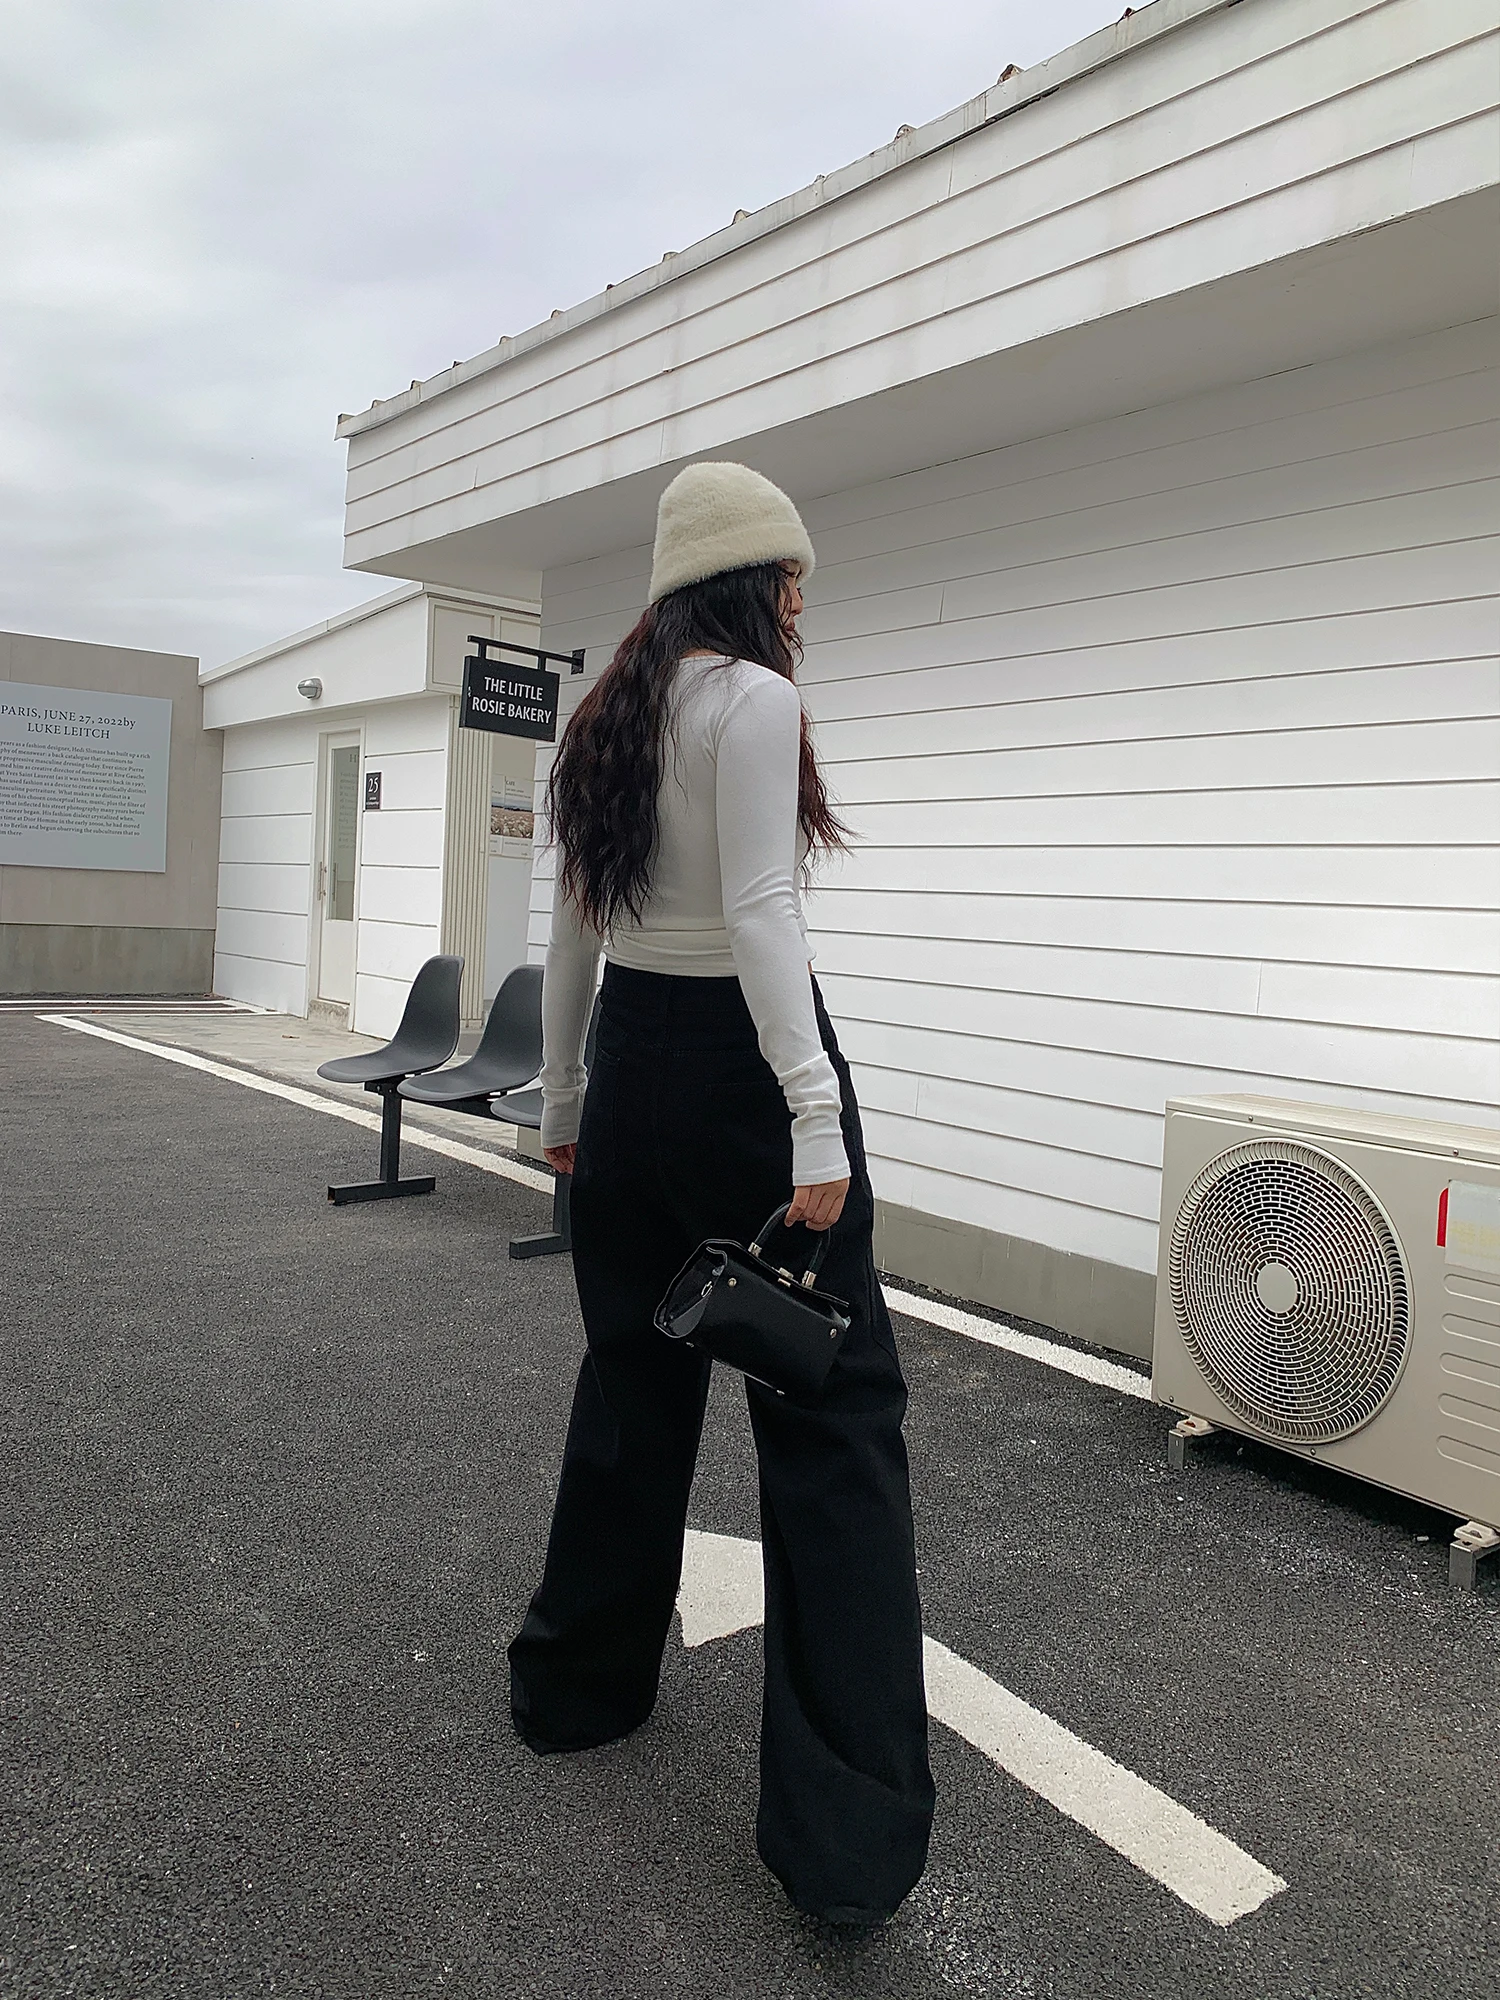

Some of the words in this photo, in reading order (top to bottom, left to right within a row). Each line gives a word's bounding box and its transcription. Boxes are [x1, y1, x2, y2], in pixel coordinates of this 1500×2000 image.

[484, 676, 506, 694] THE
[508, 681, 544, 702] LITTLE
[1, 705, 41, 718] PARIS,
[44, 709, 76, 722] JUNE
[78, 715, 94, 724] 27,
[98, 716, 136, 730] 2022by
[472, 696, 506, 716] ROSIE
[508, 703, 552, 724] BAKERY
[28, 722, 60, 735] LUKE
[64, 726, 110, 739] LEITCH
[47, 744, 70, 752] designer,
[63, 760, 84, 768] dressing
[368, 777, 378, 794] 25
[67, 805, 99, 813] photography
